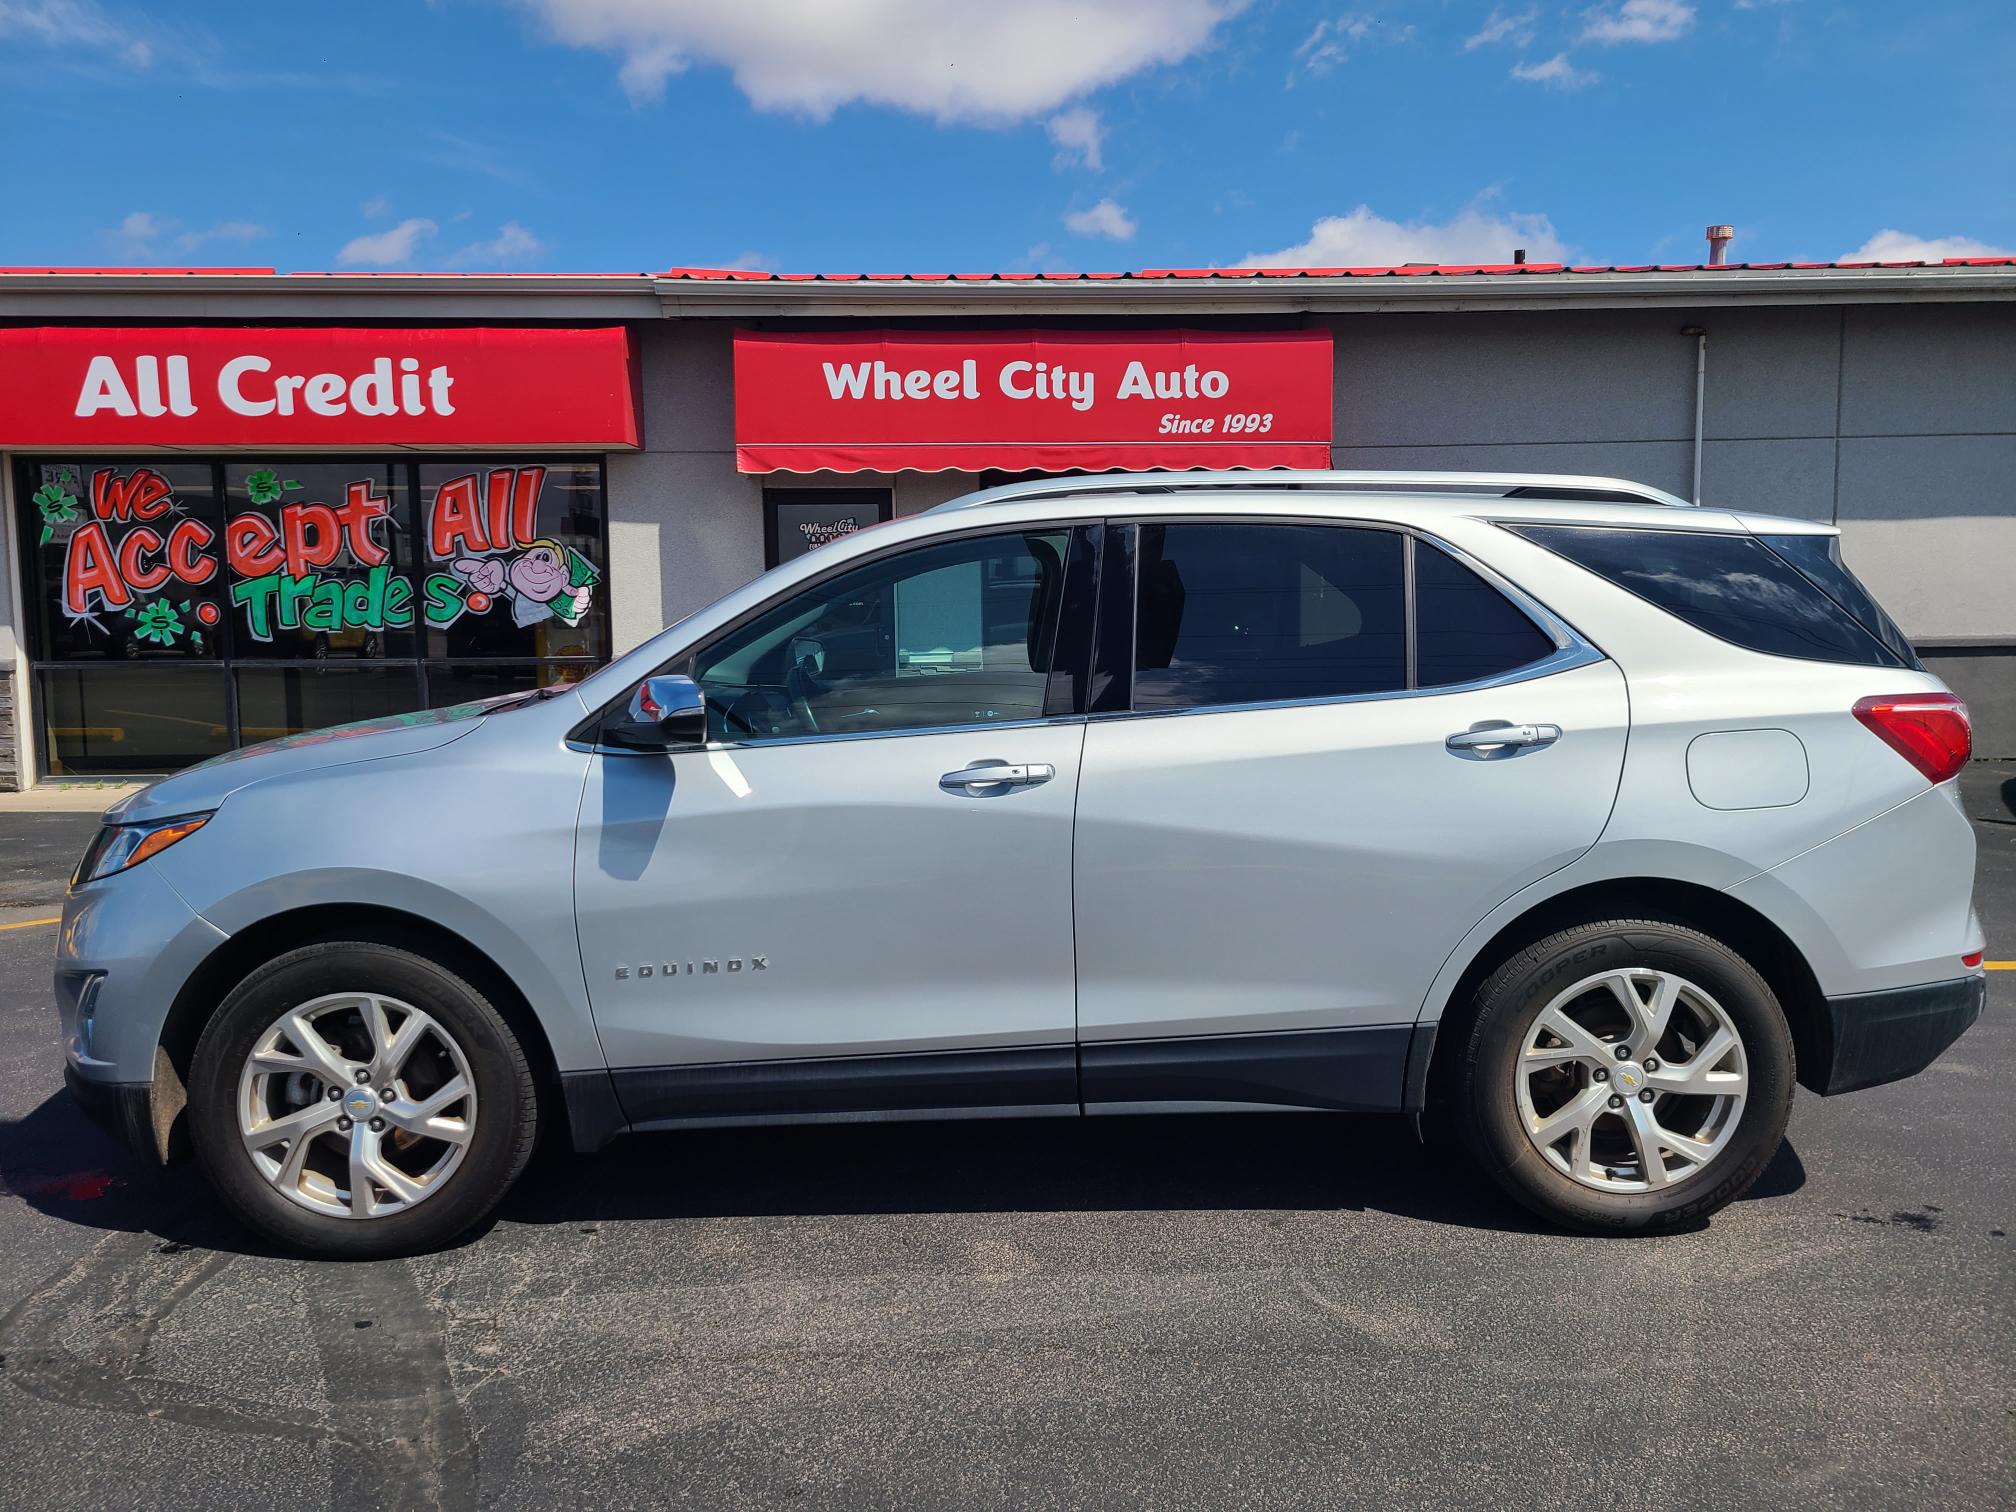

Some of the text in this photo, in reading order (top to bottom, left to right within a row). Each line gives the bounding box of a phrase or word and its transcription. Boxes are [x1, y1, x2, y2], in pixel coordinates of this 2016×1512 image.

[74, 354, 456, 418] All Credit
[822, 359, 1230, 412] Wheel City Auto
[1158, 413, 1274, 434] Since 1993
[91, 467, 174, 522] We
[429, 466, 547, 561] All
[63, 478, 391, 617] Accept
[800, 521, 837, 535] Wheel
[614, 954, 769, 981] EQUINOX
